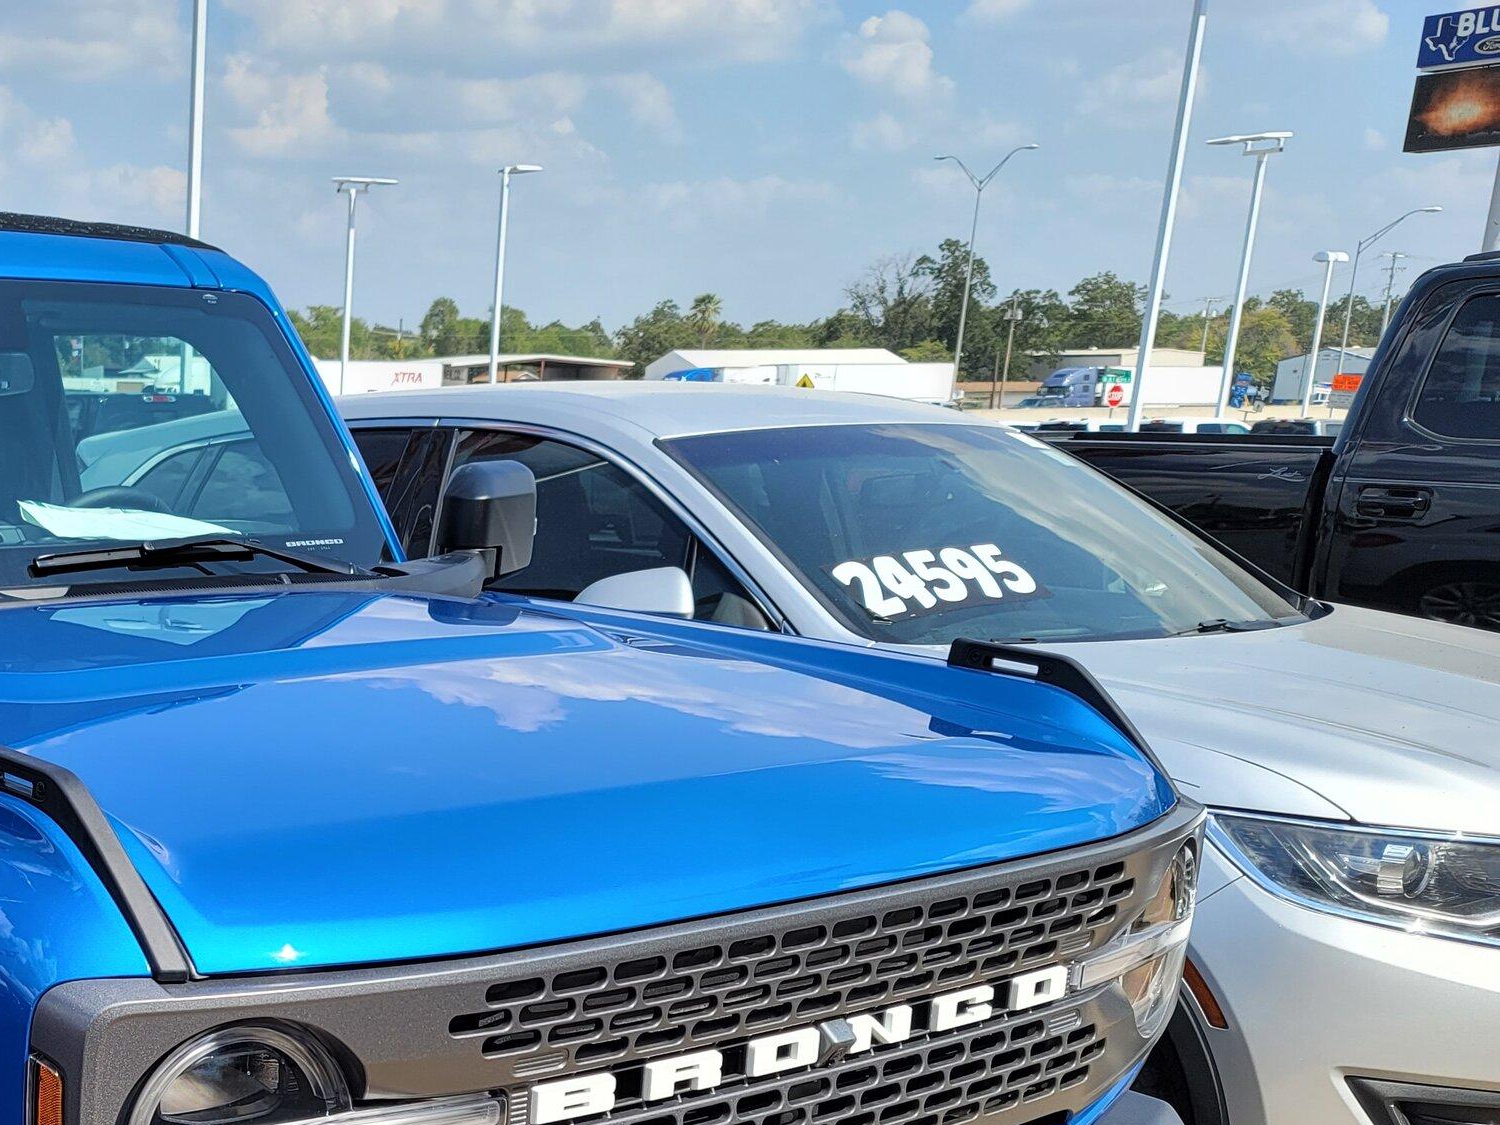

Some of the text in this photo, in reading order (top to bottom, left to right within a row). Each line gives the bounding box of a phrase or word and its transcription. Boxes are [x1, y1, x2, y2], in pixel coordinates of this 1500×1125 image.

[392, 372, 422, 385] XTRA
[285, 538, 344, 548] BRONCO
[832, 543, 1037, 616] 24595
[531, 965, 1069, 1125] BRONCO
